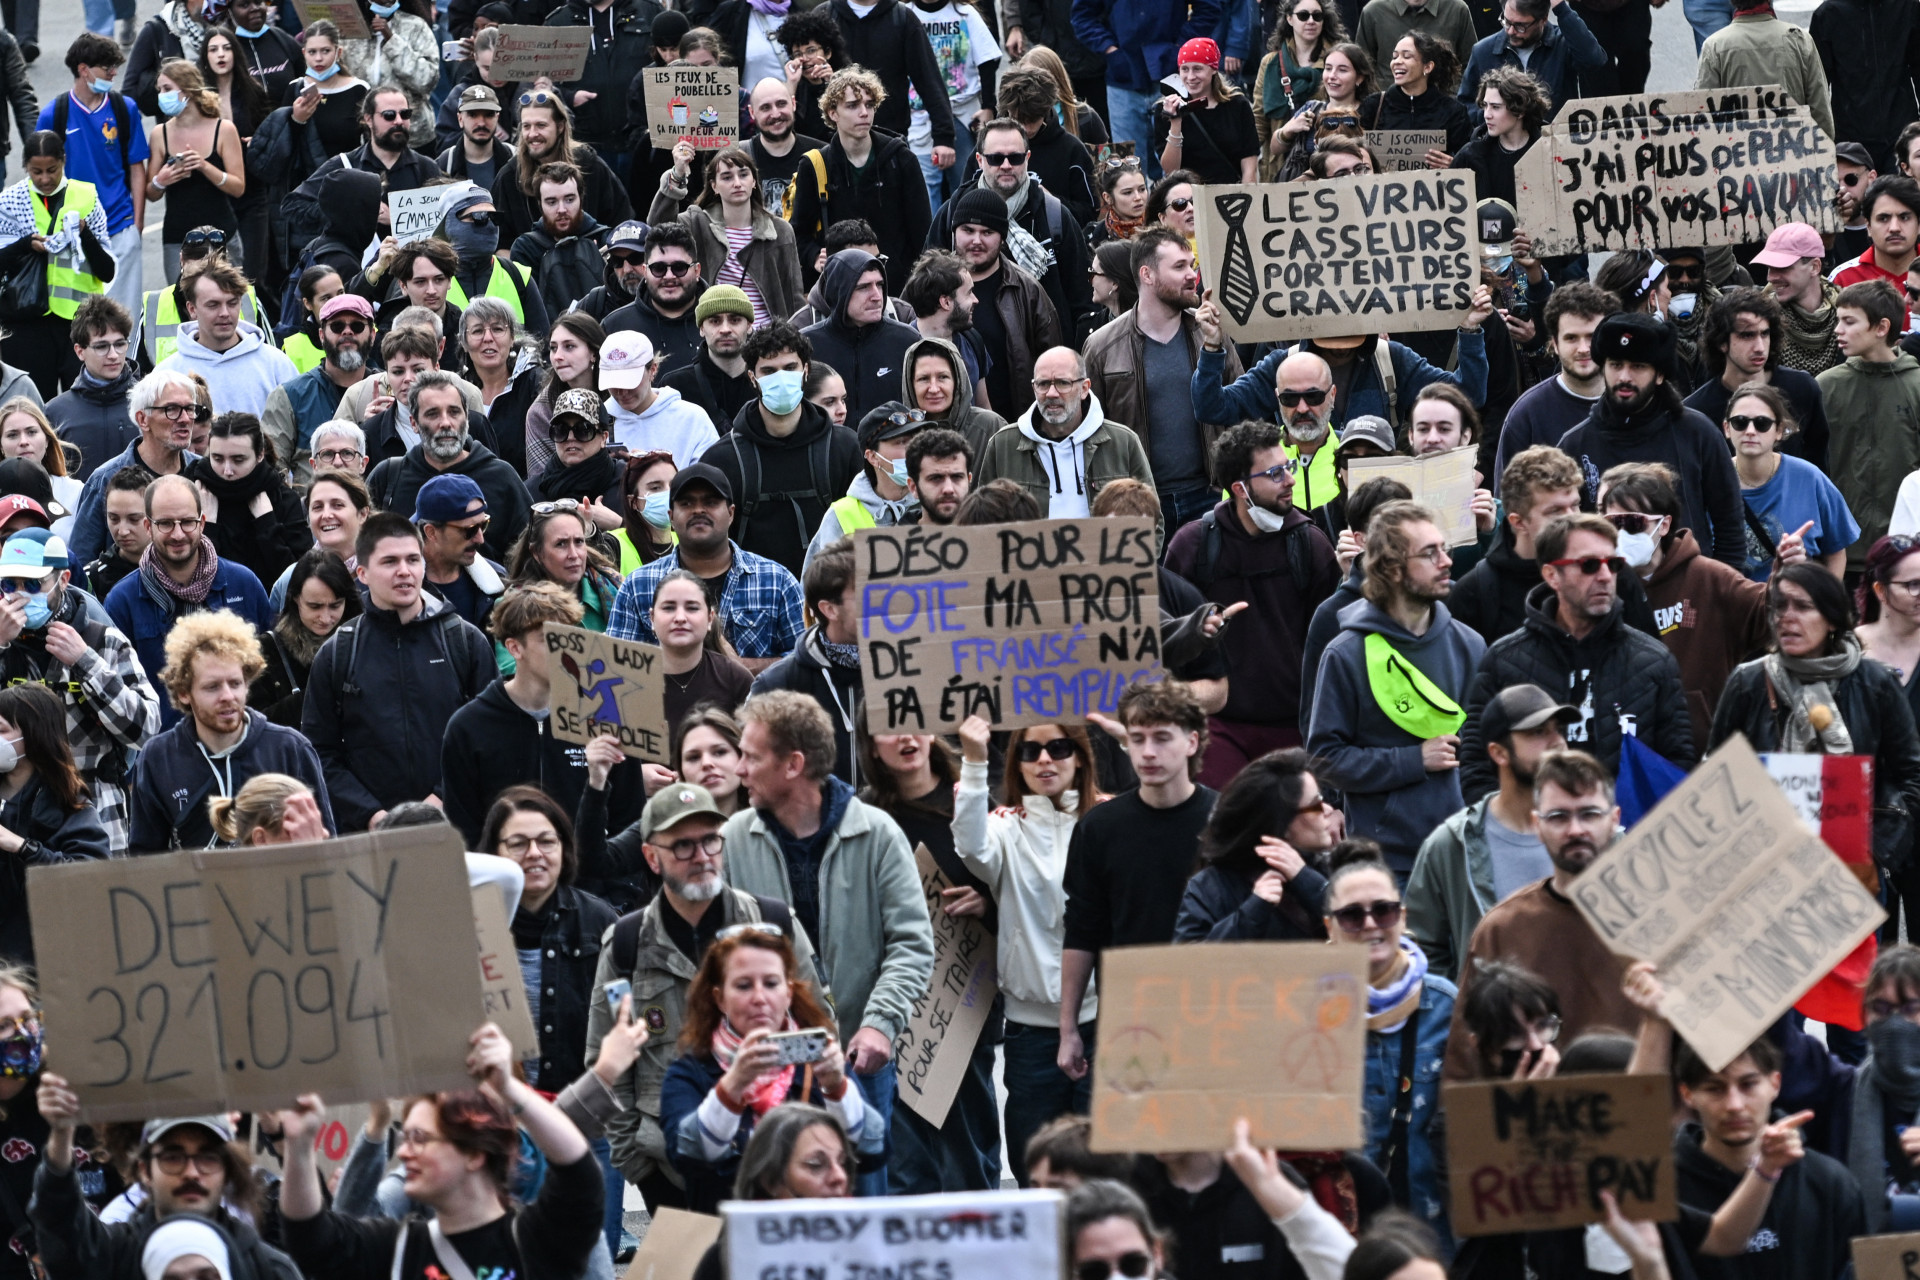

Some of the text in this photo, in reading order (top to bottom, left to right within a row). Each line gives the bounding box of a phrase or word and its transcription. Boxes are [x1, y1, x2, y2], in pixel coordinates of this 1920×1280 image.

[656, 72, 718, 84] LES FEUX DE
[675, 84, 732, 96] POUBELLES
[668, 126, 686, 134] FAIT
[690, 126, 714, 136] PEUR
[718, 126, 736, 136] AUX
[1568, 97, 1672, 145] DANS
[1707, 87, 1801, 133] VALISE
[678, 136, 731, 148] ORDURES
[1387, 147, 1413, 156] AND
[1391, 134, 1401, 146] IS
[1404, 133, 1446, 145] CATHING
[1635, 138, 1709, 181] PLUS
[1712, 142, 1746, 173] DE
[1747, 125, 1828, 166] PLACE
[398, 196, 412, 208] LA
[1263, 172, 1468, 224] LES VRAIS
[1573, 185, 1660, 246] POUR
[1717, 164, 1839, 230] BAVURES
[1261, 217, 1467, 262] CASSEURS
[1264, 253, 1472, 289] PORTENT DES
[1262, 281, 1472, 318] CRAVATTES
[12, 497, 30, 509] NY
[866, 525, 1154, 580] DÉSO POUR LES
[862, 572, 1154, 638] FOTE MA PROF
[546, 632, 655, 674] BOSS LADY
[868, 636, 922, 680] DE
[951, 623, 1086, 674] FRANSÉ
[556, 706, 582, 735] SE
[883, 685, 925, 730] PA
[1575, 762, 1760, 940] RECYCLEZ
[106, 858, 398, 976] DEWEY
[907, 924, 981, 1096] POUR SE TAIRE
[1132, 973, 1306, 1025] FUCK
[85, 958, 390, 1088] 321.094
[1171, 1020, 1244, 1067] LE
[1492, 1085, 1614, 1142] MAKE
[1469, 1154, 1661, 1223] RICH PAY
[756, 1214, 870, 1245] BABY
